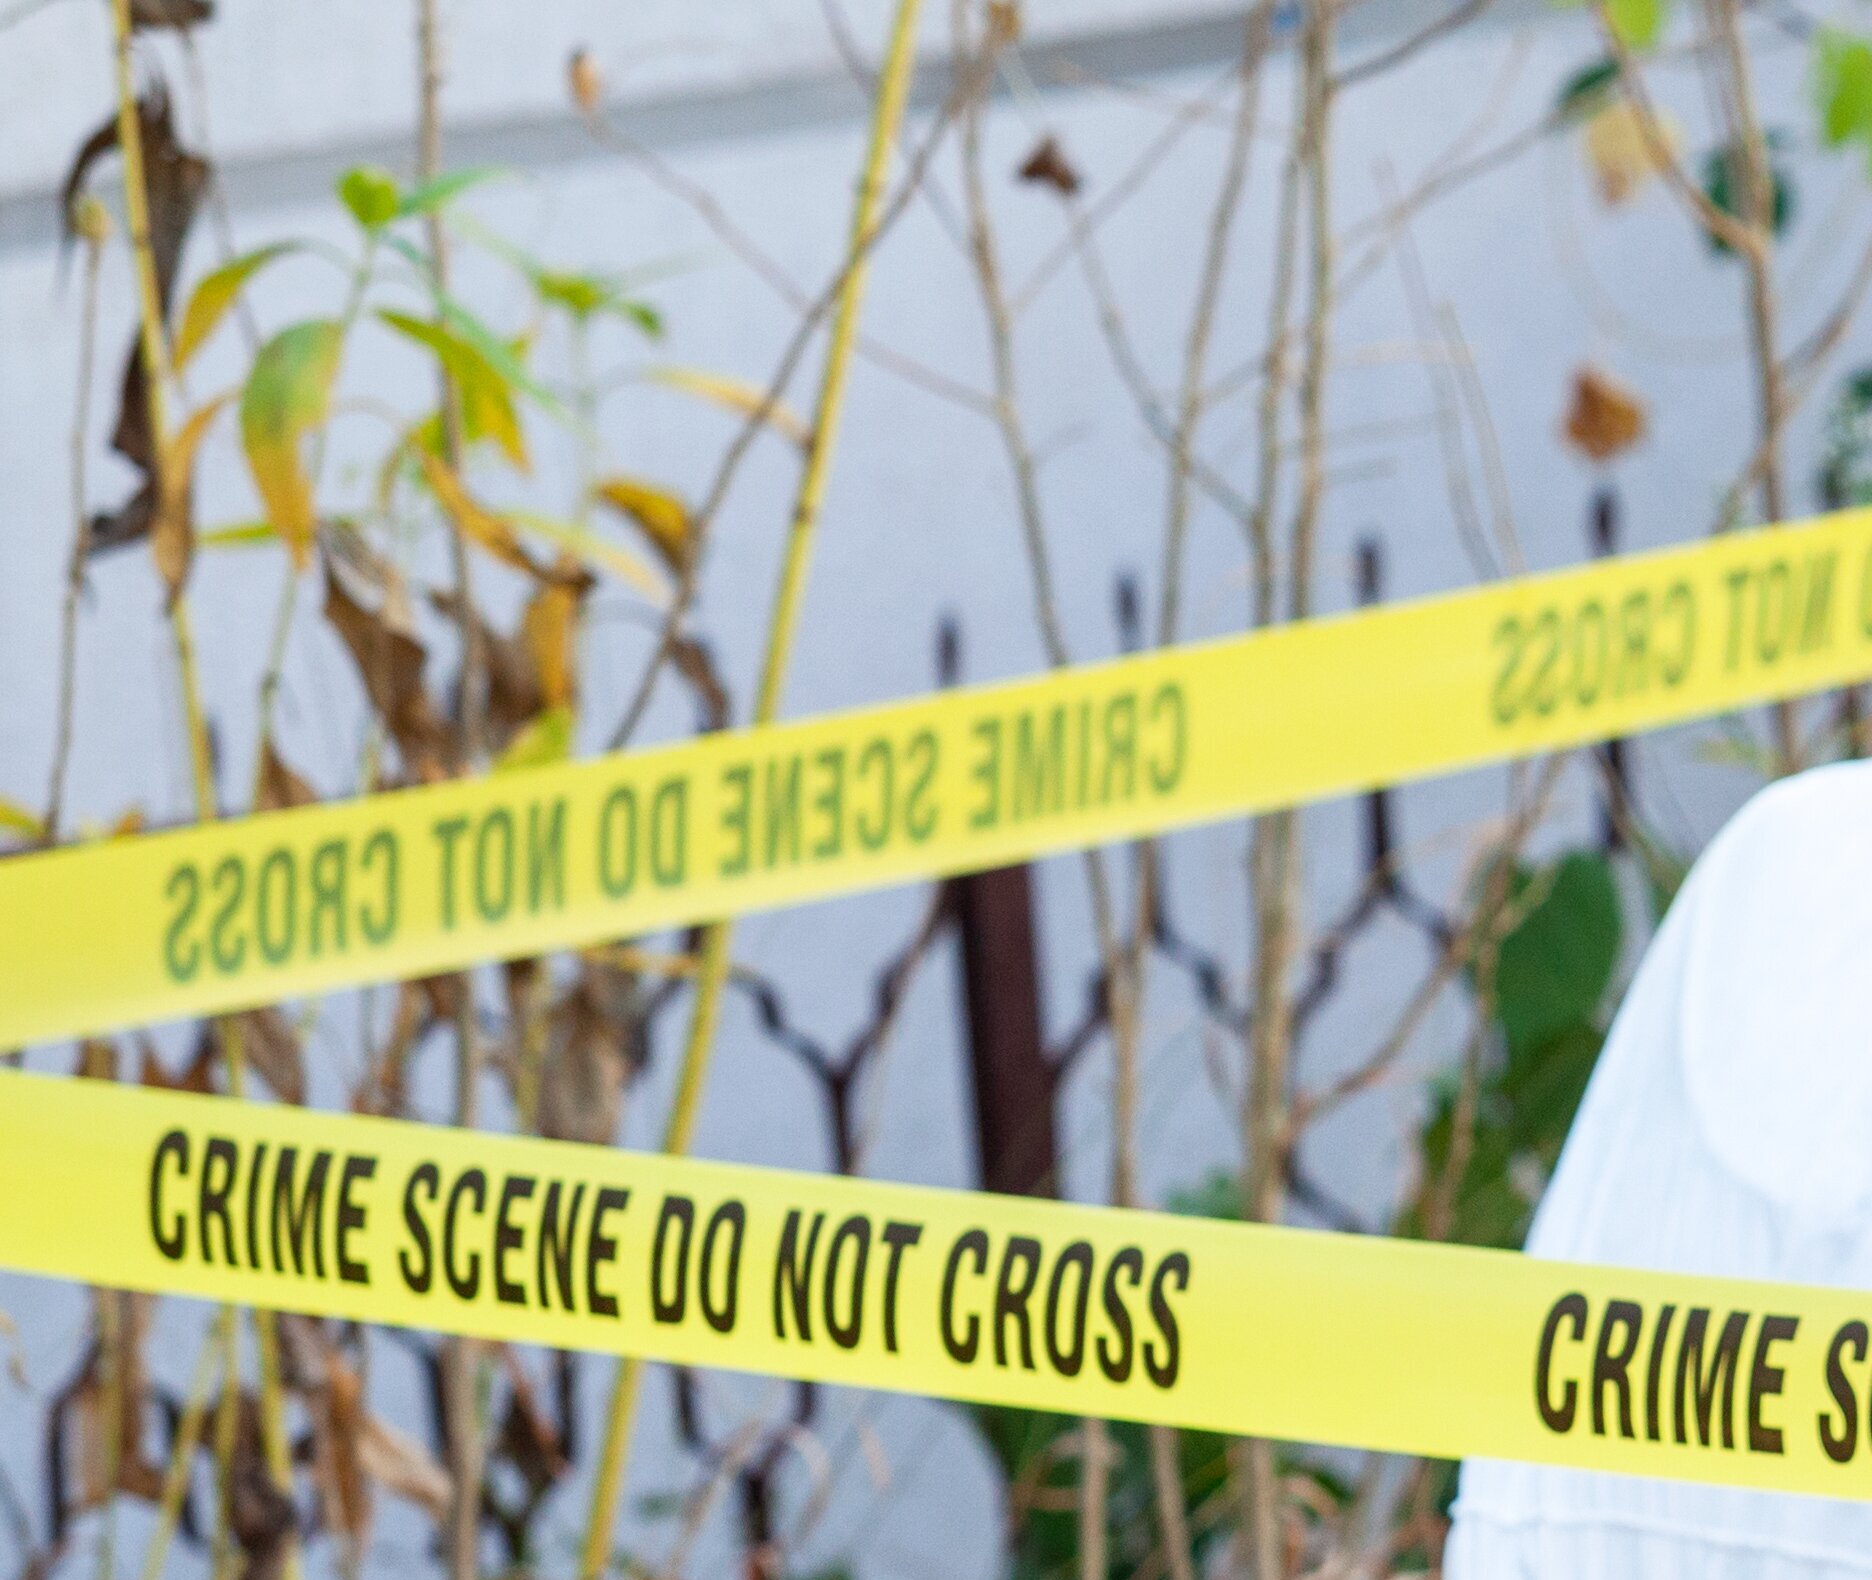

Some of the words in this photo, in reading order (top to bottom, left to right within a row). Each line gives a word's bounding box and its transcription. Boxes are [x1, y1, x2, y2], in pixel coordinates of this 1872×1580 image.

[150, 1130, 378, 1284] CRIME
[399, 1162, 631, 1318] SCENE
[651, 1195, 747, 1334] DO
[773, 1209, 923, 1353] NOT
[939, 1229, 1190, 1389] CROSS
[1534, 1291, 1800, 1455] CRIME
